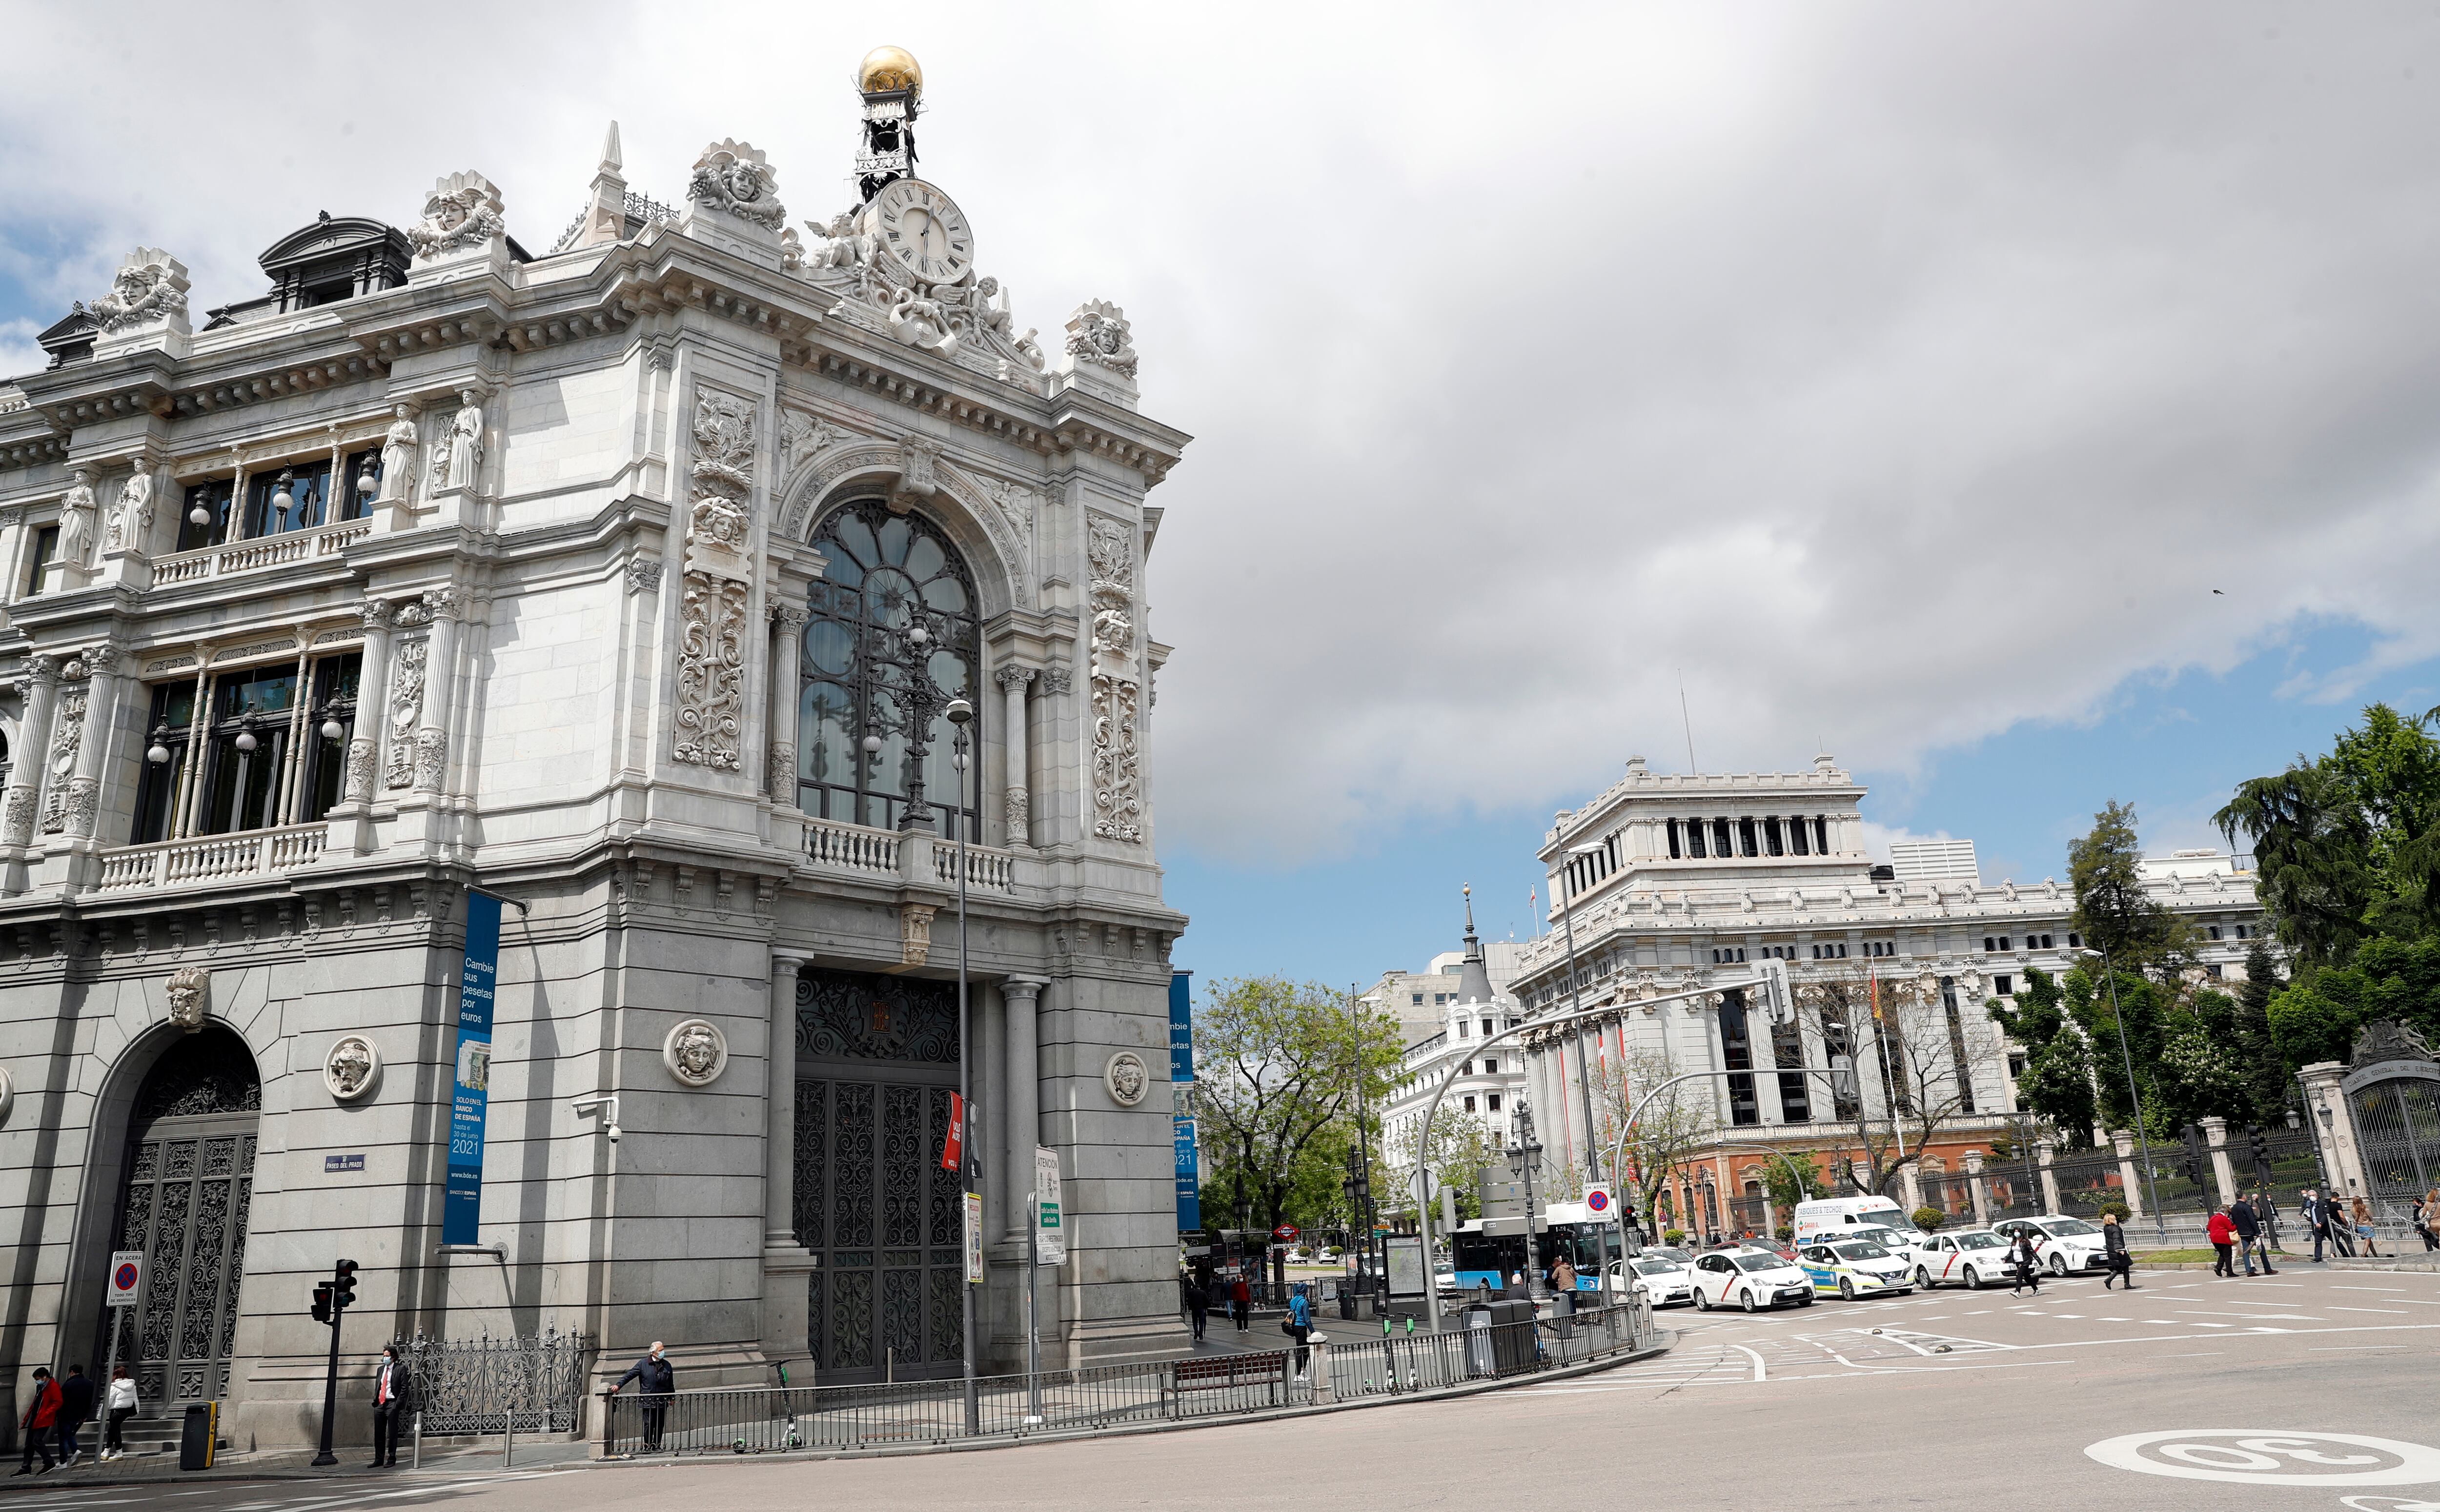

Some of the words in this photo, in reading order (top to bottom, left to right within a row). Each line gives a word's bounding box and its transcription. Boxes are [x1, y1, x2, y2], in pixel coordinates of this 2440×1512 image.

[904, 189, 913, 202] XI
[891, 196, 901, 208] X
[466, 958, 494, 973] Cambie
[464, 972, 477, 982] sus
[463, 986, 492, 999] pesetas
[462, 999, 476, 1008] por
[461, 1012, 482, 1023] euros
[2348, 1074, 2368, 1087] CUARTEL
[2371, 1067, 2395, 1076] GENERAL
[452, 1139, 478, 1155] 2021
[1037, 1157, 1057, 1169] ATENCIÓN
[1583, 1226, 1592, 1234] 146
